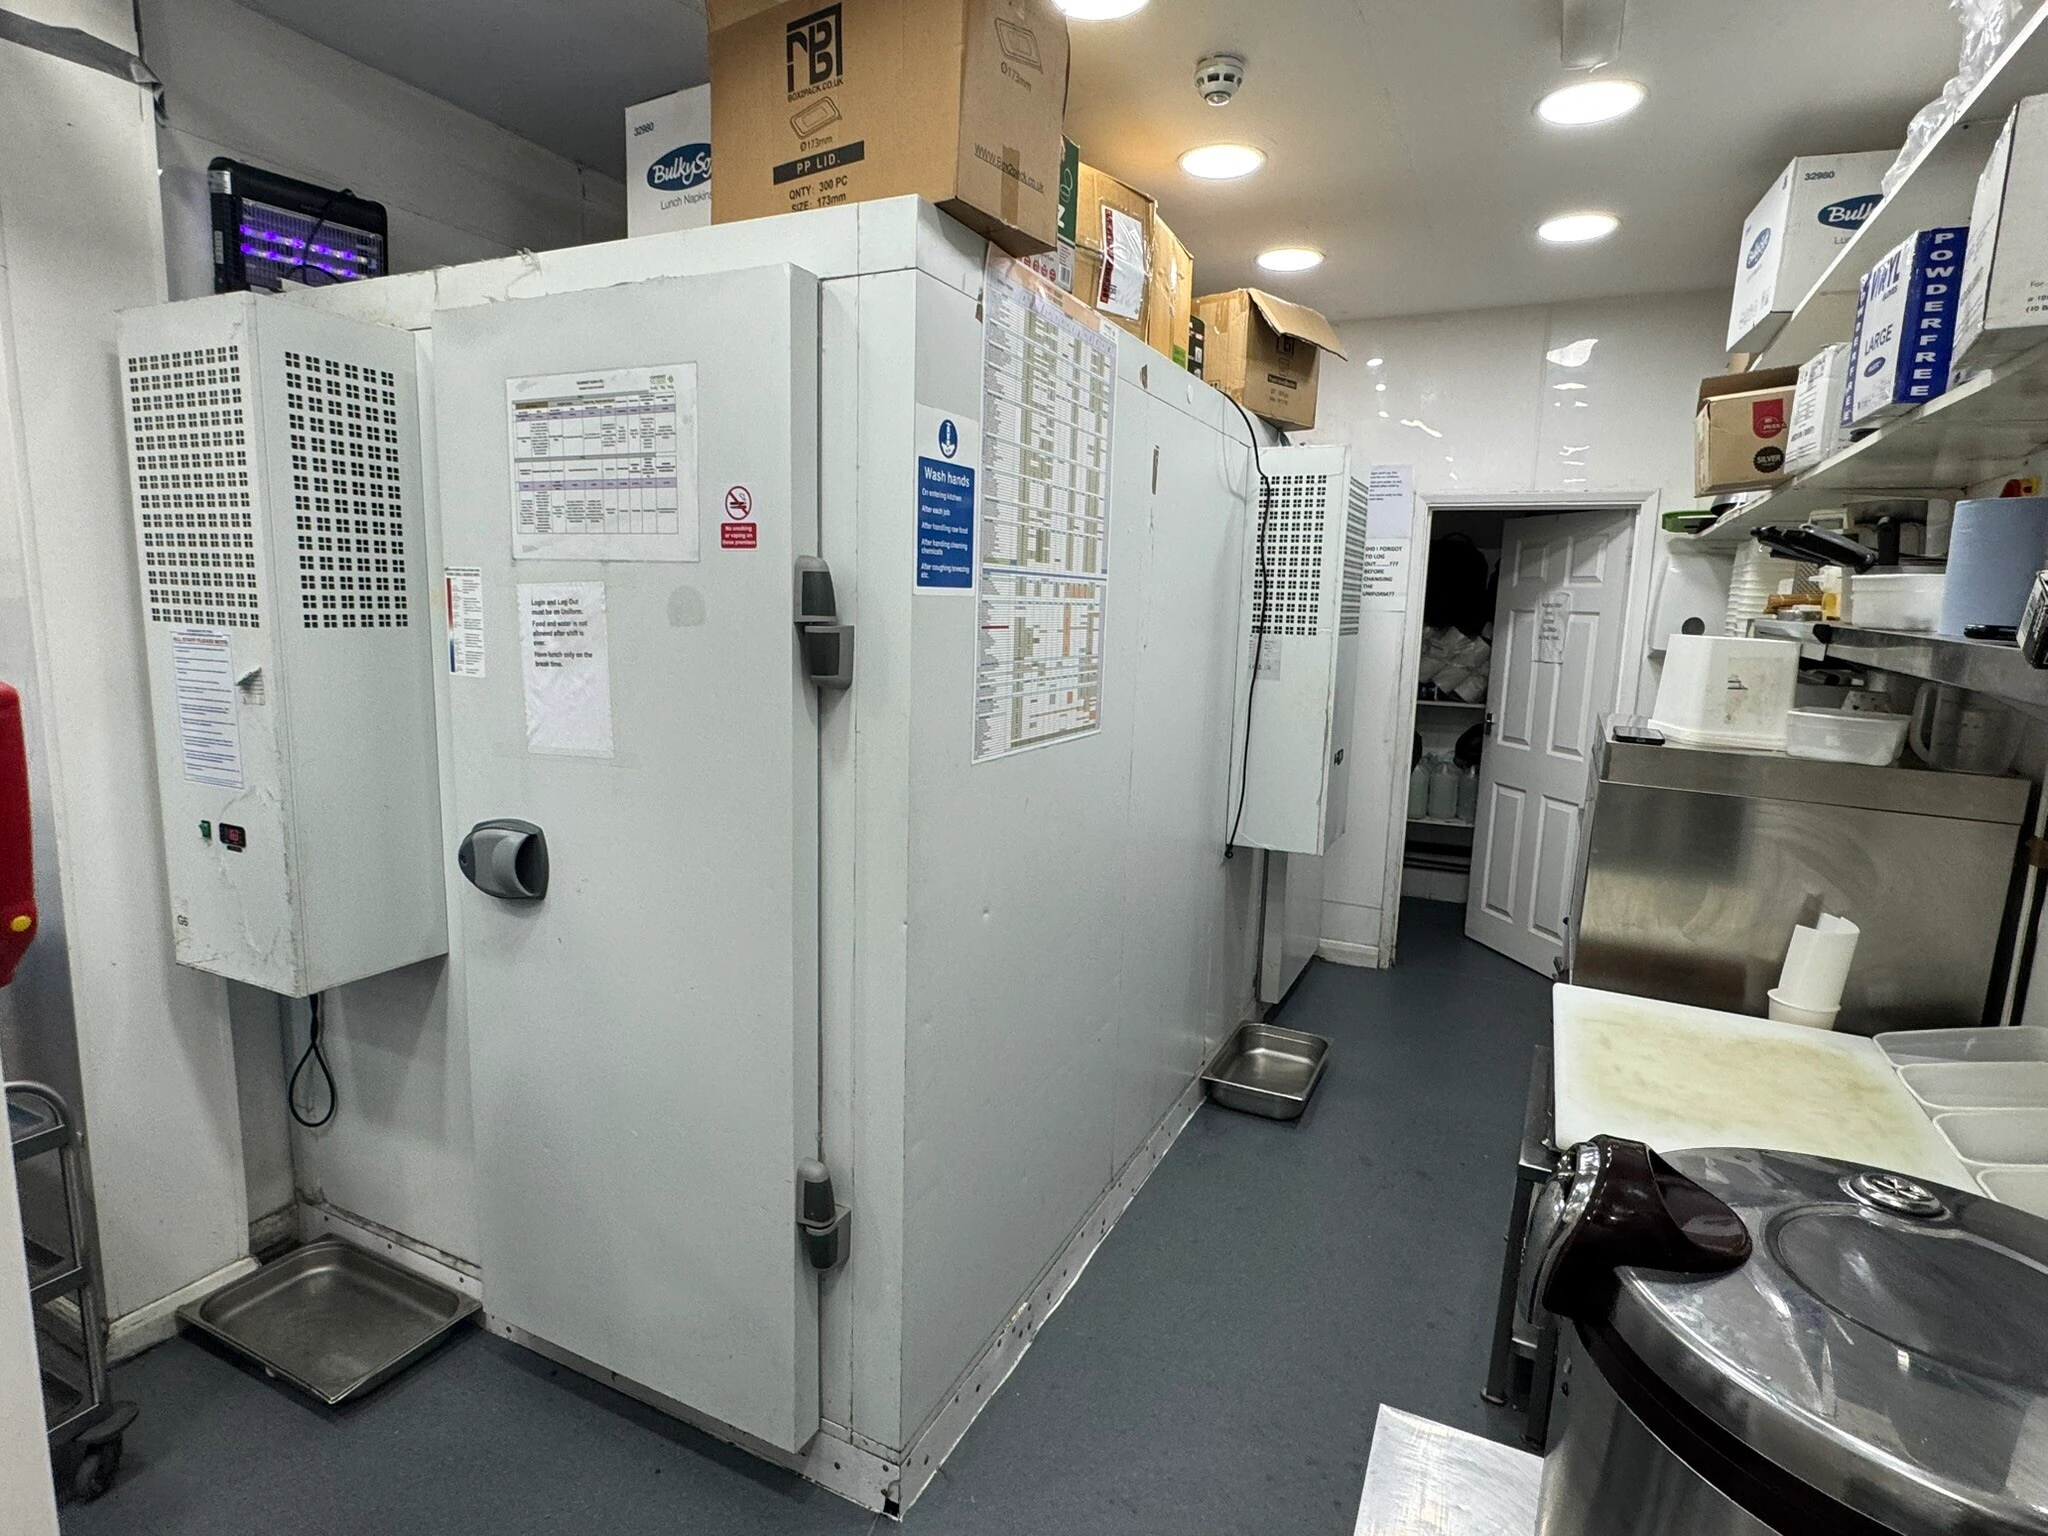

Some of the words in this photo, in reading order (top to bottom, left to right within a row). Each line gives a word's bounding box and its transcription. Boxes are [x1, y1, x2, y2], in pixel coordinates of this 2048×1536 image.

[797, 160, 811, 175] PP
[816, 153, 841, 169] LID.
[1804, 171, 1836, 181] 32980
[789, 185, 815, 200] QNTY:
[819, 179, 834, 192] 300
[835, 175, 848, 188] PC
[661, 197, 683, 210] Lunch
[817, 193, 847, 207] 173mm
[1864, 324, 1894, 356] LARGE
[1756, 454, 1782, 464] SILVER
[924, 466, 946, 482] Wash
[947, 471, 970, 487] hands
[921, 504, 932, 513] After
[921, 521, 932, 530] After
[921, 538, 932, 546] After
